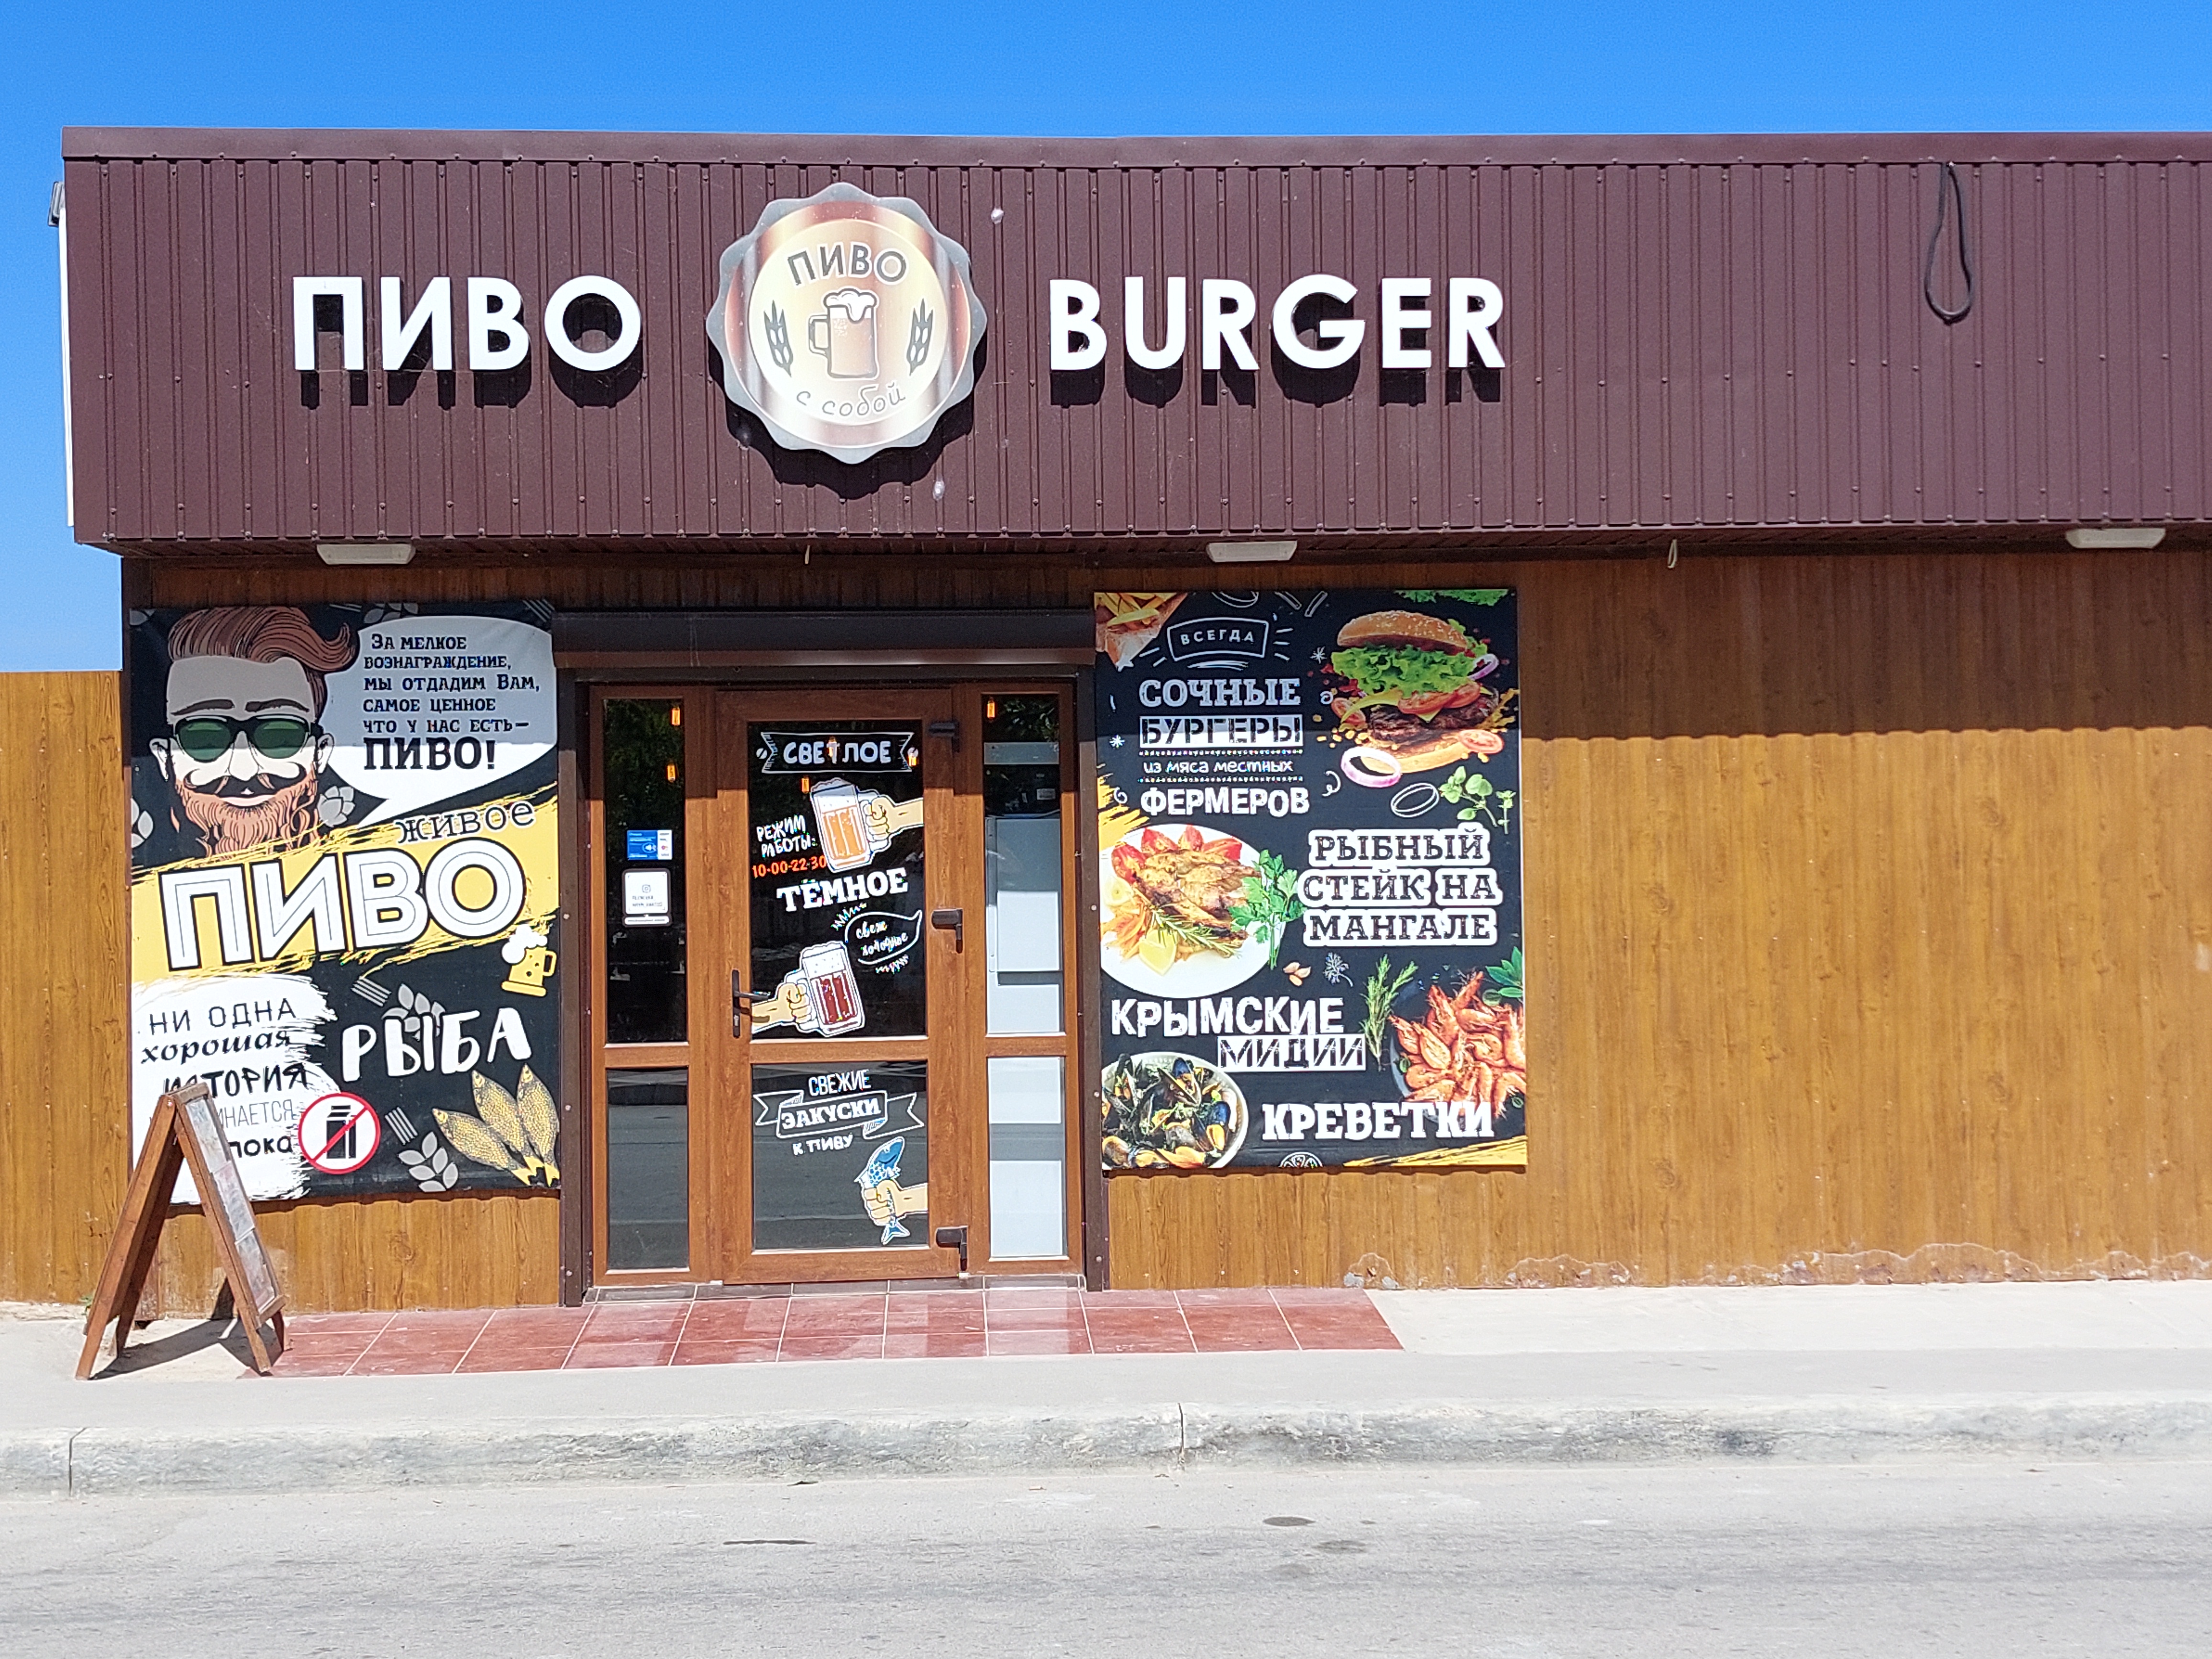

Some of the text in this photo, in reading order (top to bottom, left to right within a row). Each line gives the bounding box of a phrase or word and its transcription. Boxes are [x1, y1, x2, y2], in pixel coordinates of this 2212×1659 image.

[787, 243, 907, 286] ПИВО
[293, 275, 641, 371] ПИВО
[1050, 274, 1505, 371] BURGER
[821, 382, 906, 416] собой
[1180, 629, 1254, 645] ВСЕГДА
[1138, 677, 1301, 708] СОЧНЫЕ
[1140, 717, 1301, 745] БУРГЕРЫ
[363, 736, 496, 770] ПИВО!
[783, 741, 892, 765] СВЕТЛОЕ
[1165, 761, 1209, 774] мяса
[1213, 760, 1294, 773] местных
[1140, 786, 1310, 818] ФЕРМЕРОВ
[398, 801, 534, 843] живое
[756, 815, 807, 842] РЕЖИМ
[761, 834, 816, 858] РАБОТЫ:
[1314, 828, 1484, 861] РЫБНЫЙ
[776, 867, 908, 912] ТЁМНОЕ
[1302, 868, 1496, 900] СТЕЙК НА
[159, 837, 526, 971] ПИВО
[1310, 914, 1490, 941] МАНГАЛЕ
[149, 997, 297, 1036] НИ ОДНА
[1110, 995, 1344, 1038] КРЫМСКИЕ
[141, 1030, 291, 1065] хорошая
[342, 1006, 532, 1083] РЫБА
[1219, 1037, 1364, 1069] МИДИИ
[808, 1069, 872, 1096] СВЕЖИЕ
[781, 1098, 882, 1129] ЗАКУСКИ
[1262, 1100, 1495, 1141] КРЕВЕТКИ
[806, 1133, 853, 1153] ПИВУ
